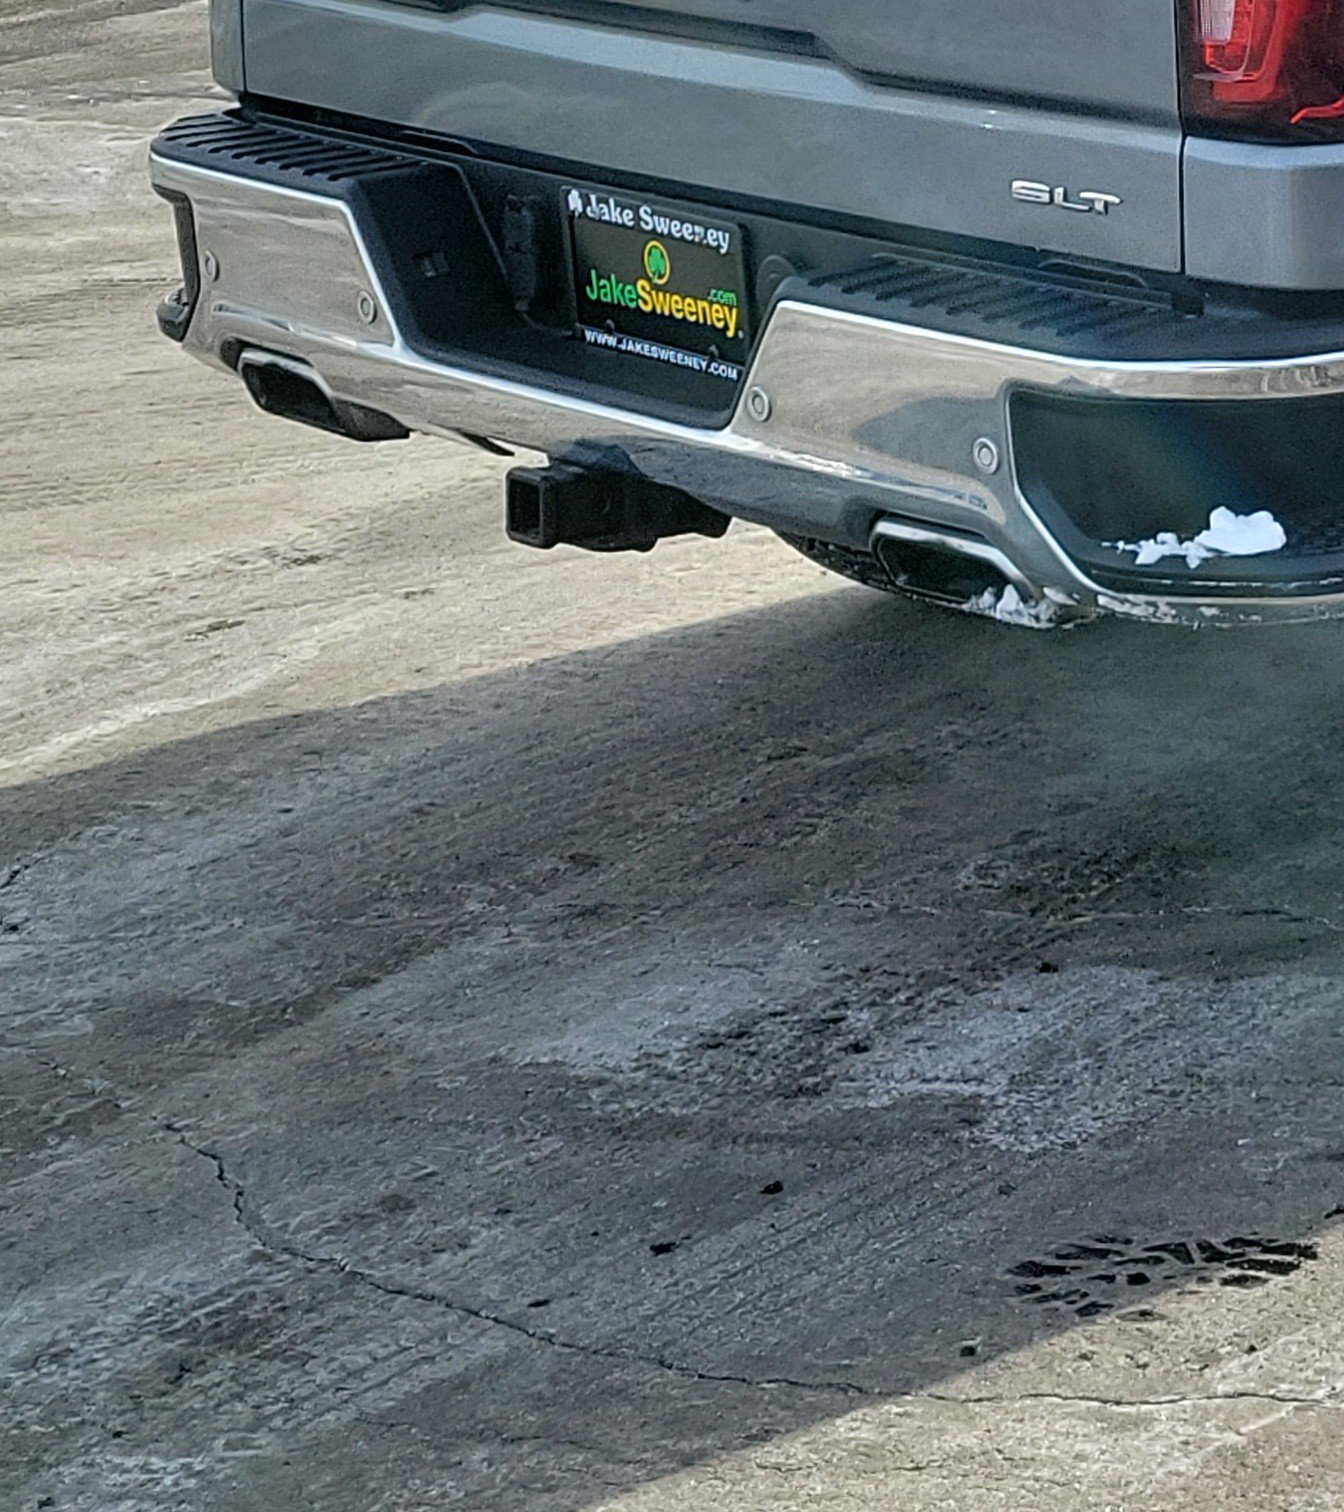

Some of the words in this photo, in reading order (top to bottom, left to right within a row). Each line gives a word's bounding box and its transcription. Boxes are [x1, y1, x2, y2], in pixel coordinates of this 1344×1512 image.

[1011, 179, 1122, 214] SLT
[585, 193, 634, 227] Jake
[639, 205, 730, 254] Sweeney
[584, 329, 738, 381] WWW.JAKESWEENEY.COM
